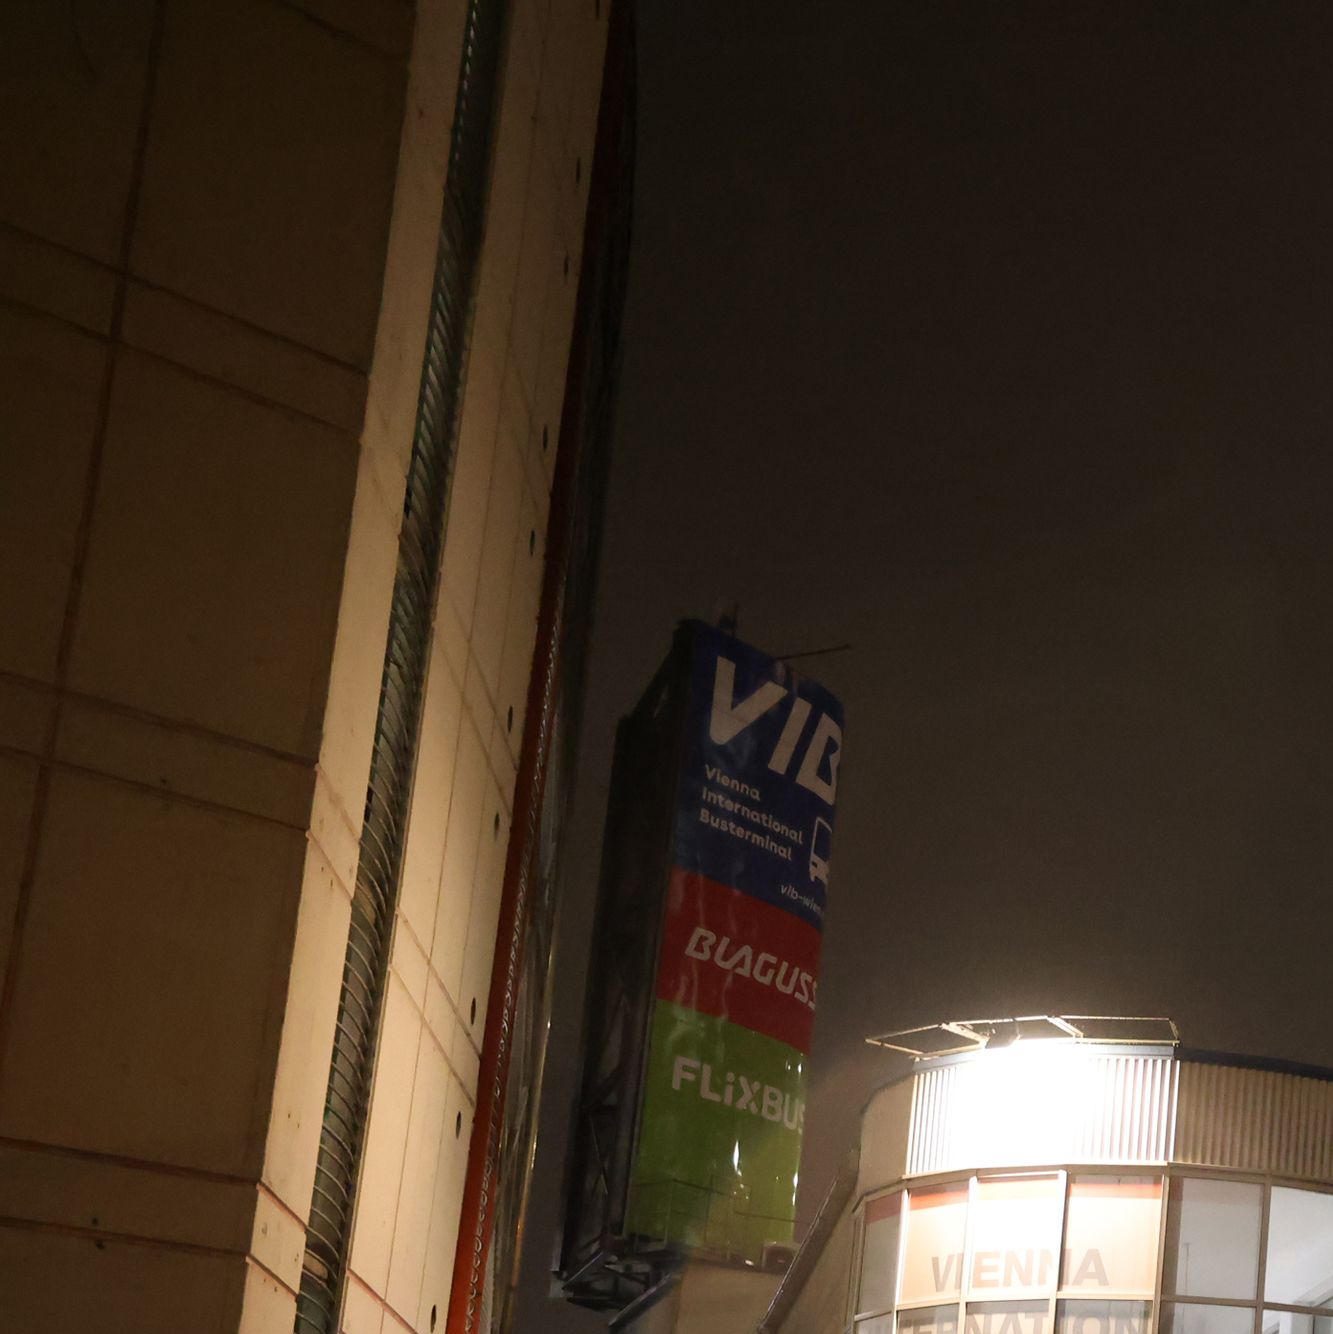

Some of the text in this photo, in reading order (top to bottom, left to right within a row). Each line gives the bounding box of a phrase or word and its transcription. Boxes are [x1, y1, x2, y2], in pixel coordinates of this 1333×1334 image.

[710, 655, 842, 805] VIB
[705, 764, 760, 801] Vienna
[699, 809, 793, 862] Busterminal
[702, 786, 804, 844] International
[931, 1249, 1110, 1293] VIENNA
